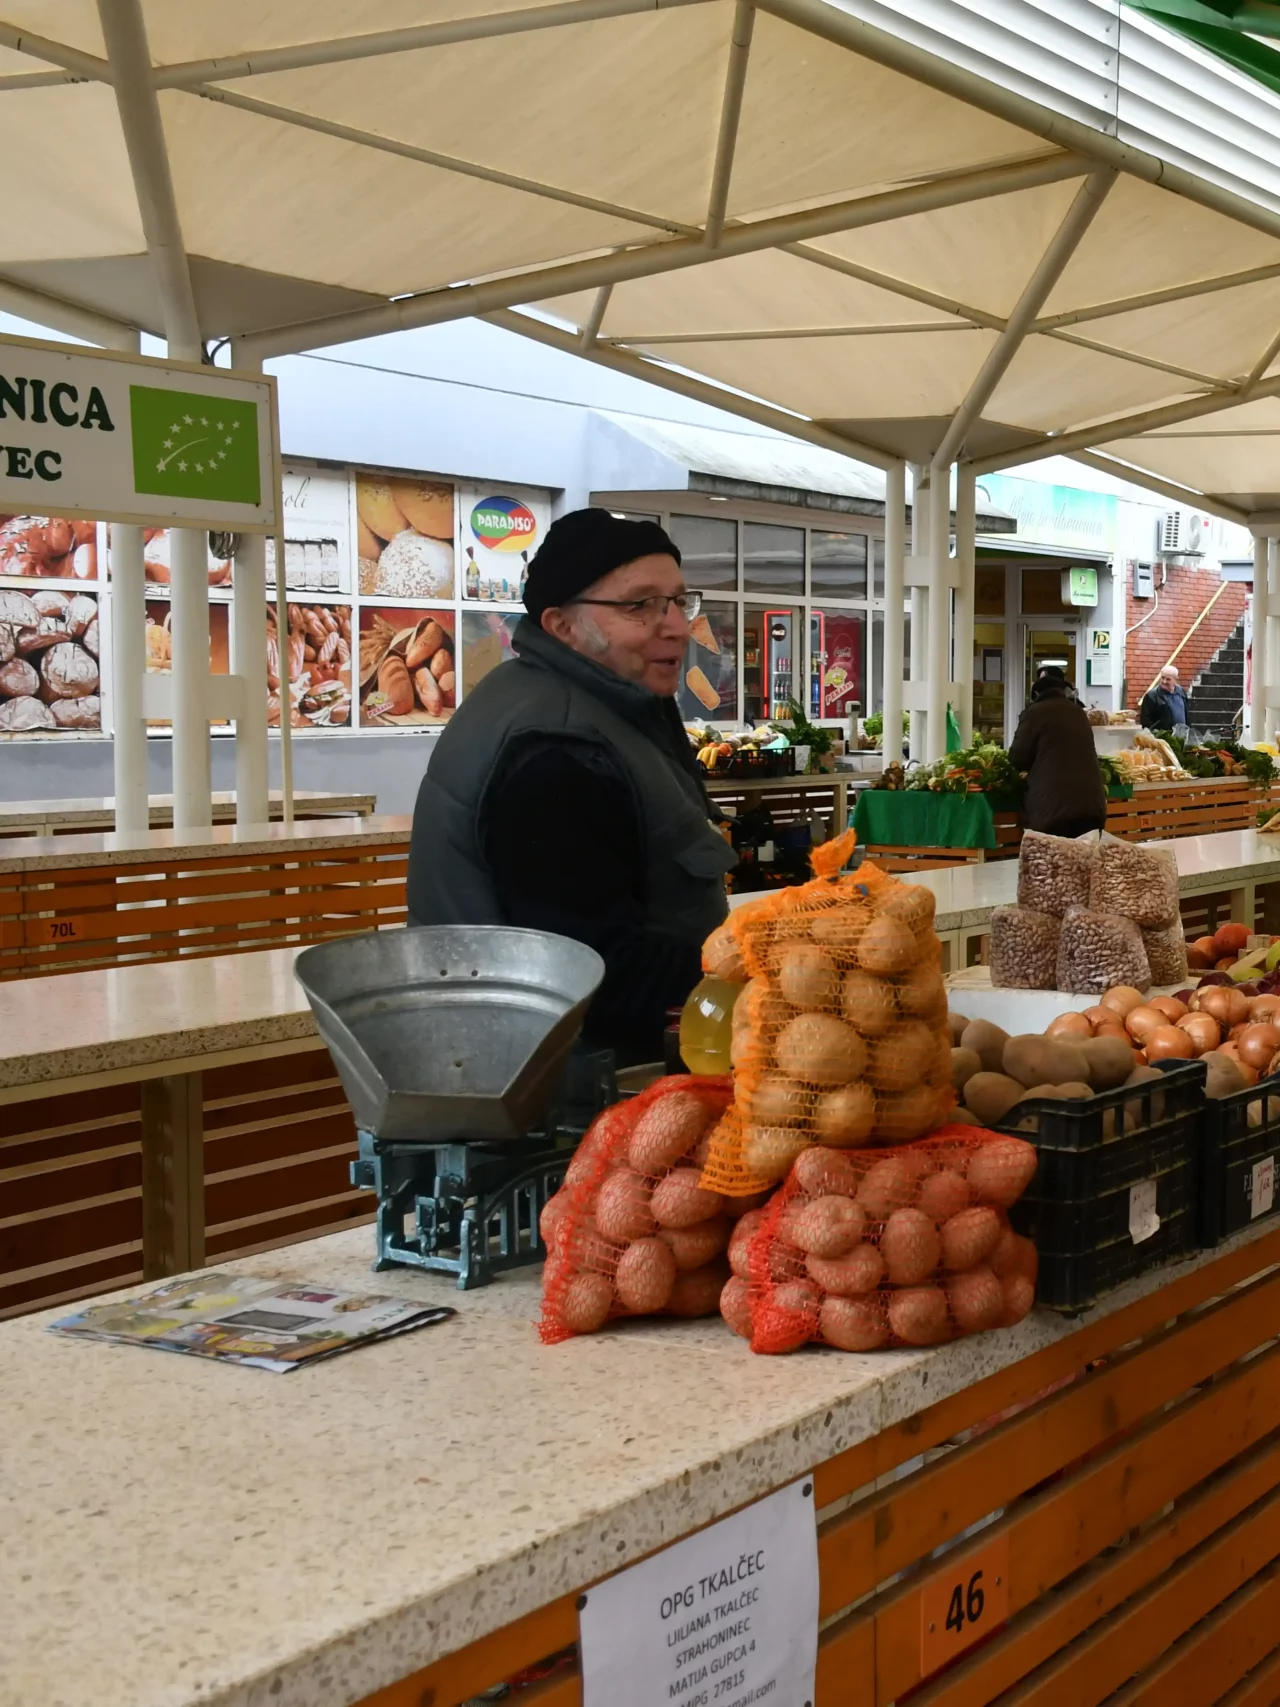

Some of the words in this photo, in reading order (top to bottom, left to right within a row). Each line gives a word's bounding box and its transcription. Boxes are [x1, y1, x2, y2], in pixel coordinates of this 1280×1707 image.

[0, 446, 63, 482] EC
[476, 513, 532, 532] PARADISO
[50, 921, 76, 938] 70L
[660, 1586, 695, 1620] OPG
[698, 1550, 766, 1599] TKALČEC
[945, 1569, 985, 1633] 46
[713, 1588, 760, 1622] TKALČEC
[674, 1617, 751, 1669] STRAHONINEC
[668, 1666, 708, 1698] MATIJA
[710, 1644, 747, 1674] GUPCA
[749, 1639, 756, 1652] 4
[713, 1669, 746, 1699] 27815
